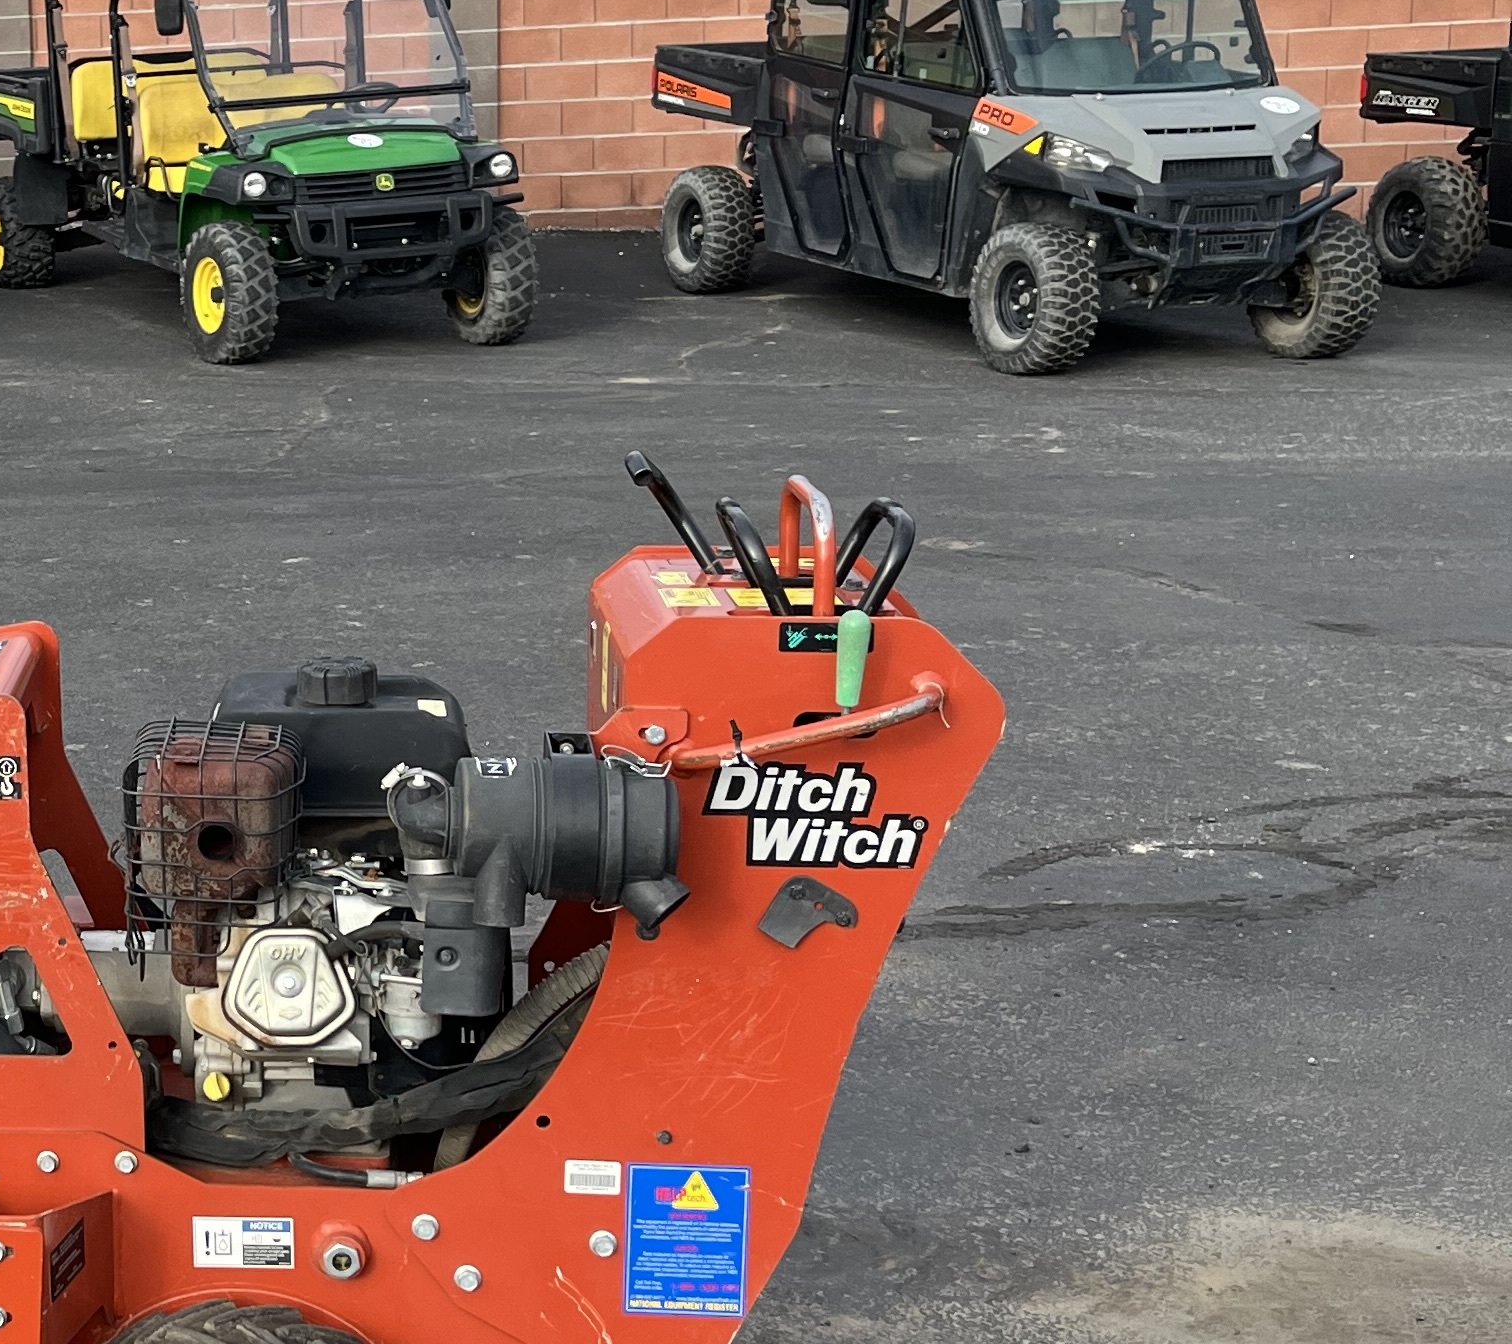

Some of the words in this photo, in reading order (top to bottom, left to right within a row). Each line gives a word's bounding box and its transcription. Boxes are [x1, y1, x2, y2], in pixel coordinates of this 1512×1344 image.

[660, 79, 697, 98] POLARIS
[979, 104, 1014, 126] PRO
[972, 121, 990, 135] XD
[709, 766, 872, 813] Ditch
[752, 817, 917, 864] Witch
[270, 947, 307, 961] OHV
[249, 1222, 284, 1230] NOTICE
